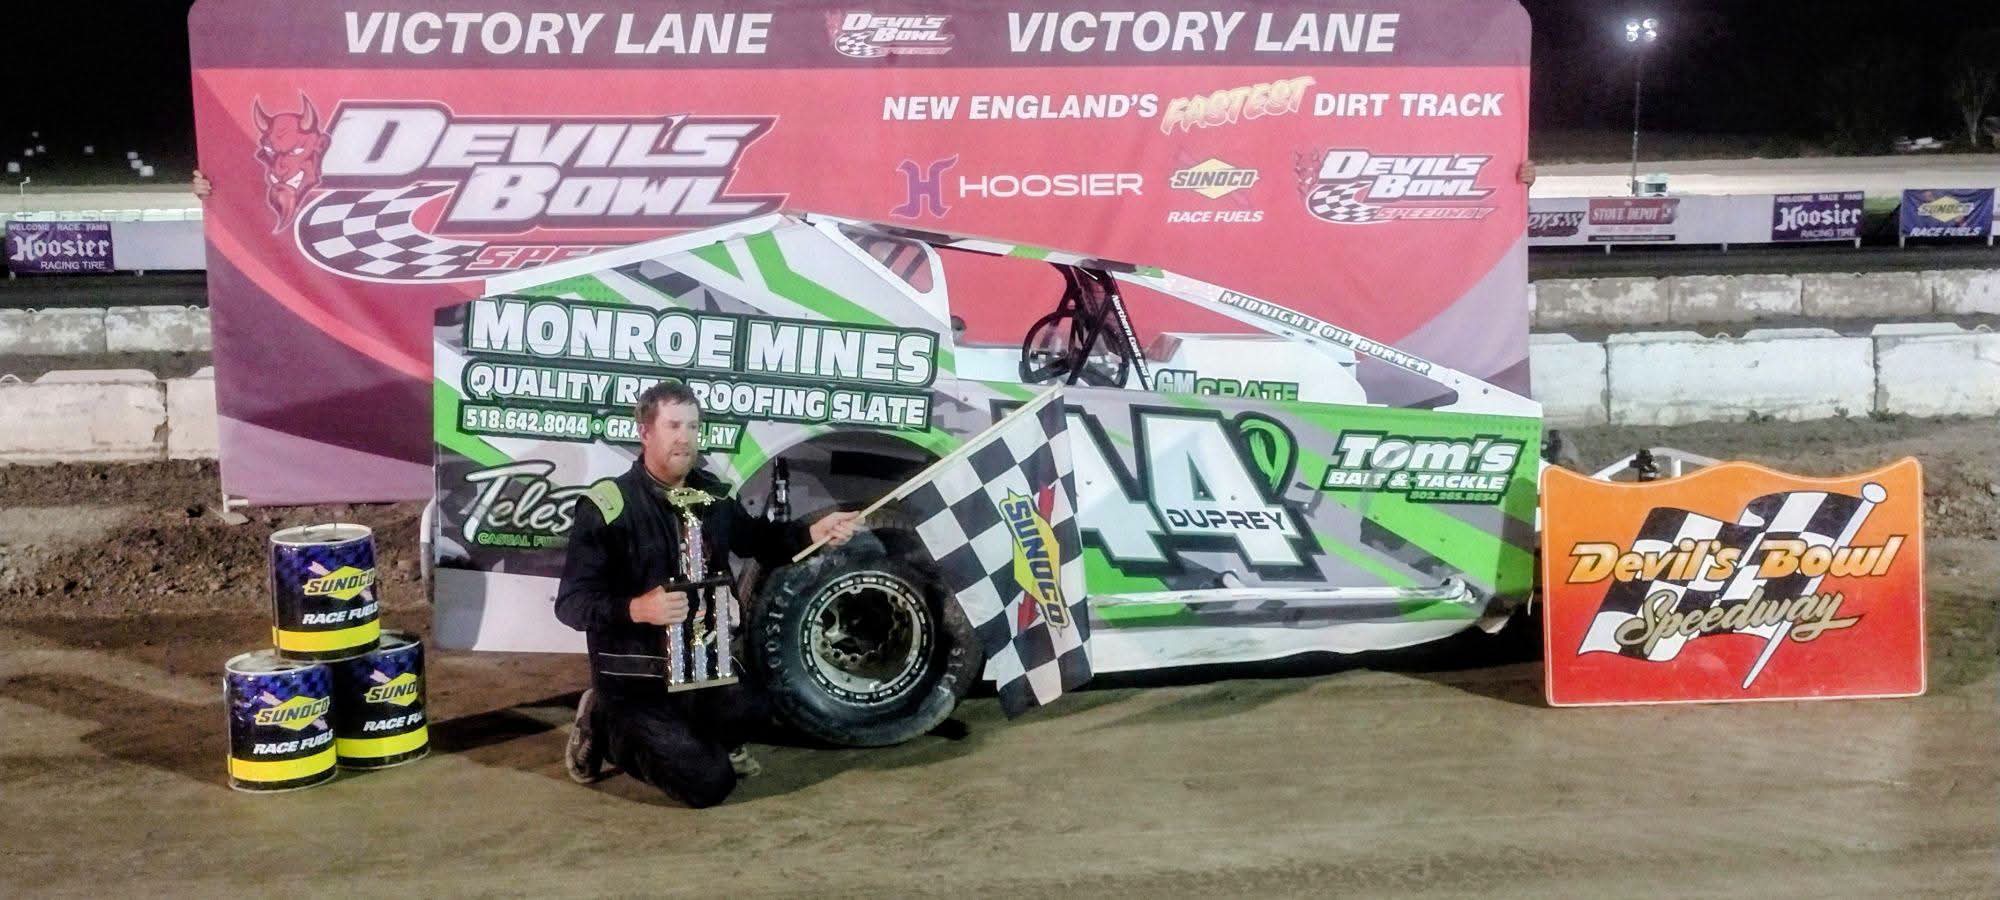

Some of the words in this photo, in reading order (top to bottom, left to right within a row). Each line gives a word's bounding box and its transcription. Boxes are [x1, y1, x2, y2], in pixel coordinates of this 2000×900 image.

[344, 12, 605, 54] VICTORY
[614, 13, 773, 54] LANE
[842, 13, 947, 30] DEVIL'S
[1008, 12, 1236, 54] VICTORY
[1254, 12, 1400, 53] LANE
[872, 28, 949, 42] BOWL
[882, 96, 959, 121] NEW
[968, 95, 1159, 120] ENGLAND'S
[1161, 76, 1315, 135] FASTEST
[1313, 93, 1389, 117] DIRT
[1400, 92, 1504, 117] TRACK
[320, 107, 758, 174] DEVIL'S
[1320, 151, 1489, 178] DEVIL'S
[959, 173, 1143, 198] HOOSIER
[1171, 169, 1256, 189] SUNOCO
[1367, 174, 1492, 199] BOWL
[448, 164, 776, 222] BOWL
[1167, 210, 1211, 224] RACE
[1215, 210, 1264, 223] FUELS
[1775, 203, 1862, 231] Hoosier
[10, 234, 110, 261] Hoosier
[41, 261, 80, 270] RACING
[472, 300, 736, 369] MONROE
[748, 321, 934, 385] MINES
[1221, 291, 1318, 332] MIDNIGHT
[1319, 324, 1354, 345] OIL
[1357, 339, 1431, 374] BURNER
[472, 365, 612, 402] QUALITY
[832, 394, 928, 426] SLATE
[465, 409, 588, 436] 518.642.8044
[711, 426, 737, 445] NY
[1341, 435, 1518, 473] Tom's
[1328, 470, 1386, 486] BAIT
[1389, 472, 1408, 488] &
[1416, 473, 1507, 490] TACKLE
[1167, 509, 1289, 531] DUPREY
[478, 532, 531, 547] CASUAL
[1006, 500, 1064, 627] SUNOCO
[1565, 537, 1743, 584] Devil's
[1756, 534, 1909, 580] Bowl
[307, 569, 375, 594] SUNOCO
[303, 610, 347, 625] RACE
[349, 603, 379, 621] FUELS
[1613, 586, 1865, 658] Speedway
[369, 680, 418, 701] SUNO
[257, 699, 330, 724] SUNOCO
[363, 716, 406, 732] RACE
[253, 740, 298, 755] RACE
[300, 730, 334, 751] FUELS
